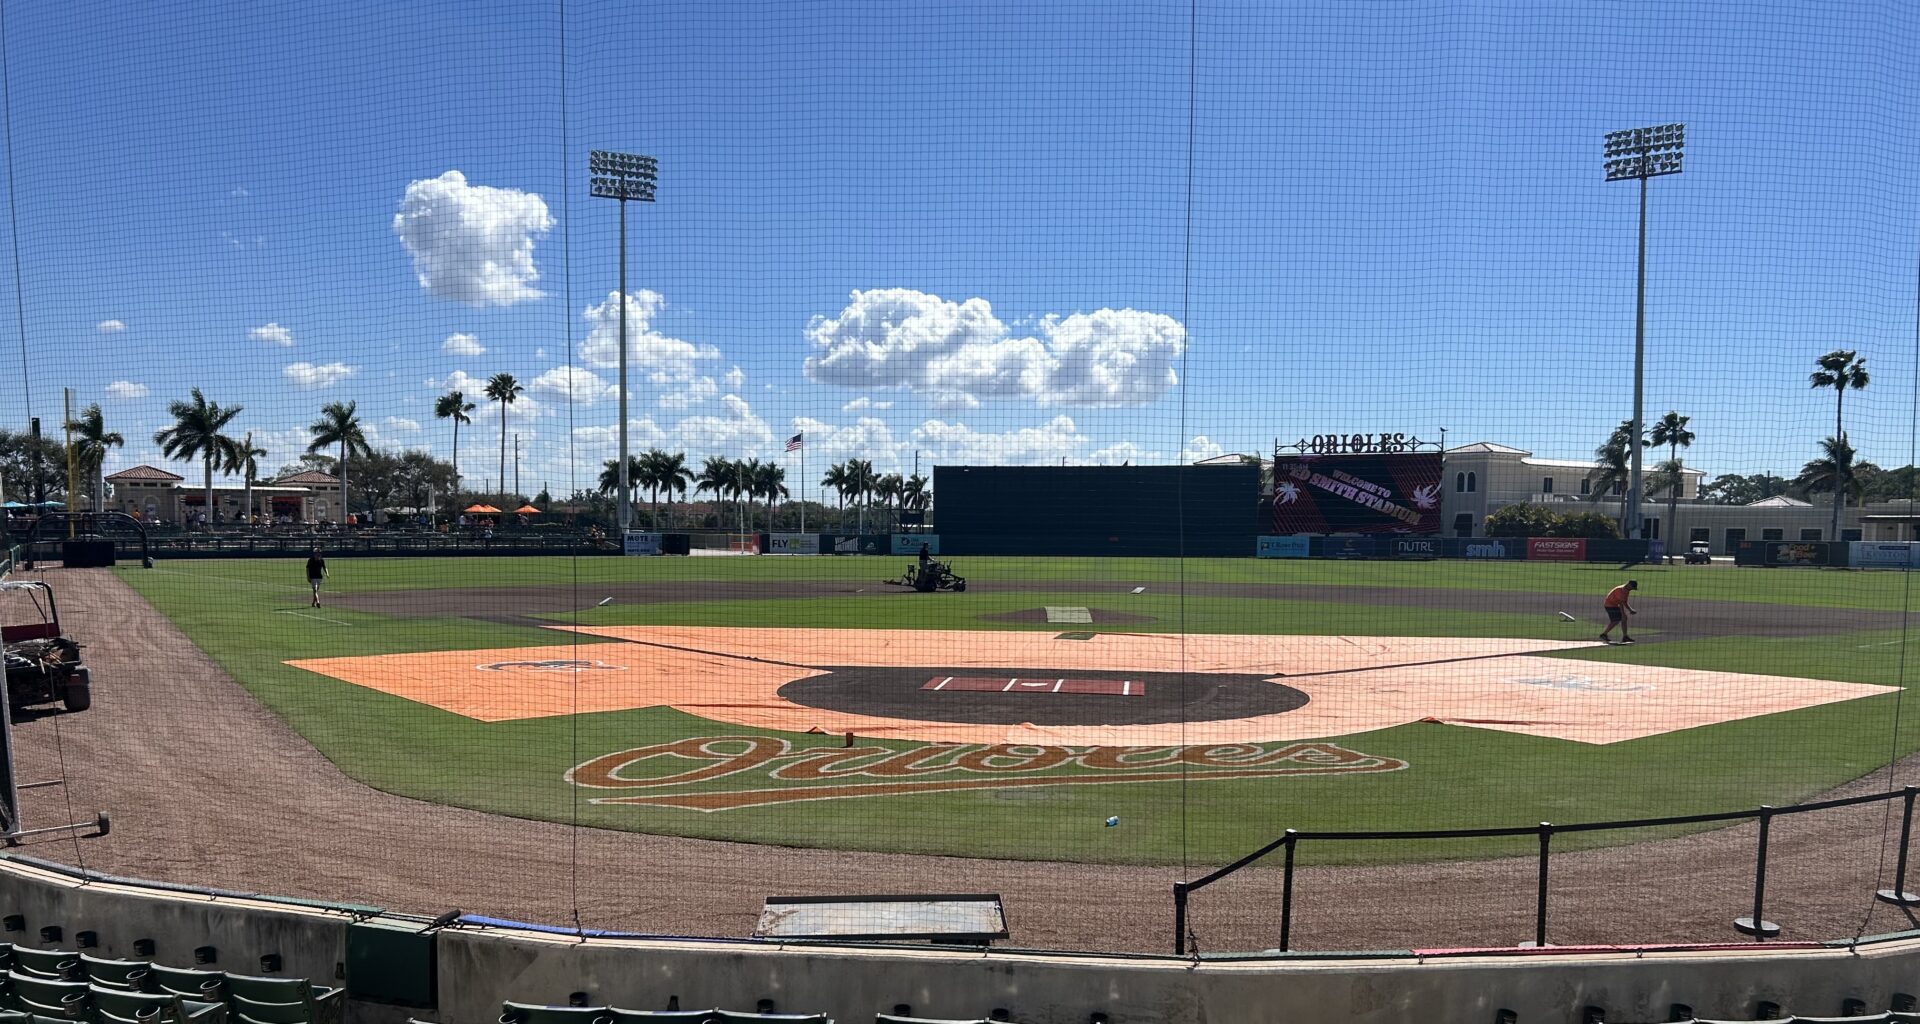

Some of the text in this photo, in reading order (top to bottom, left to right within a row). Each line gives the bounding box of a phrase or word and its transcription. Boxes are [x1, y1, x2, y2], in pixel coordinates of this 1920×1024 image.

[1312, 433, 1405, 454] ORIOLES
[1333, 469, 1392, 498] WELCOME TO
[1311, 473, 1357, 500] SMITH
[1356, 492, 1422, 525] STADIUM
[772, 539, 788, 548] FLY
[1466, 541, 1505, 557] smh
[1792, 543, 1809, 551] Food
